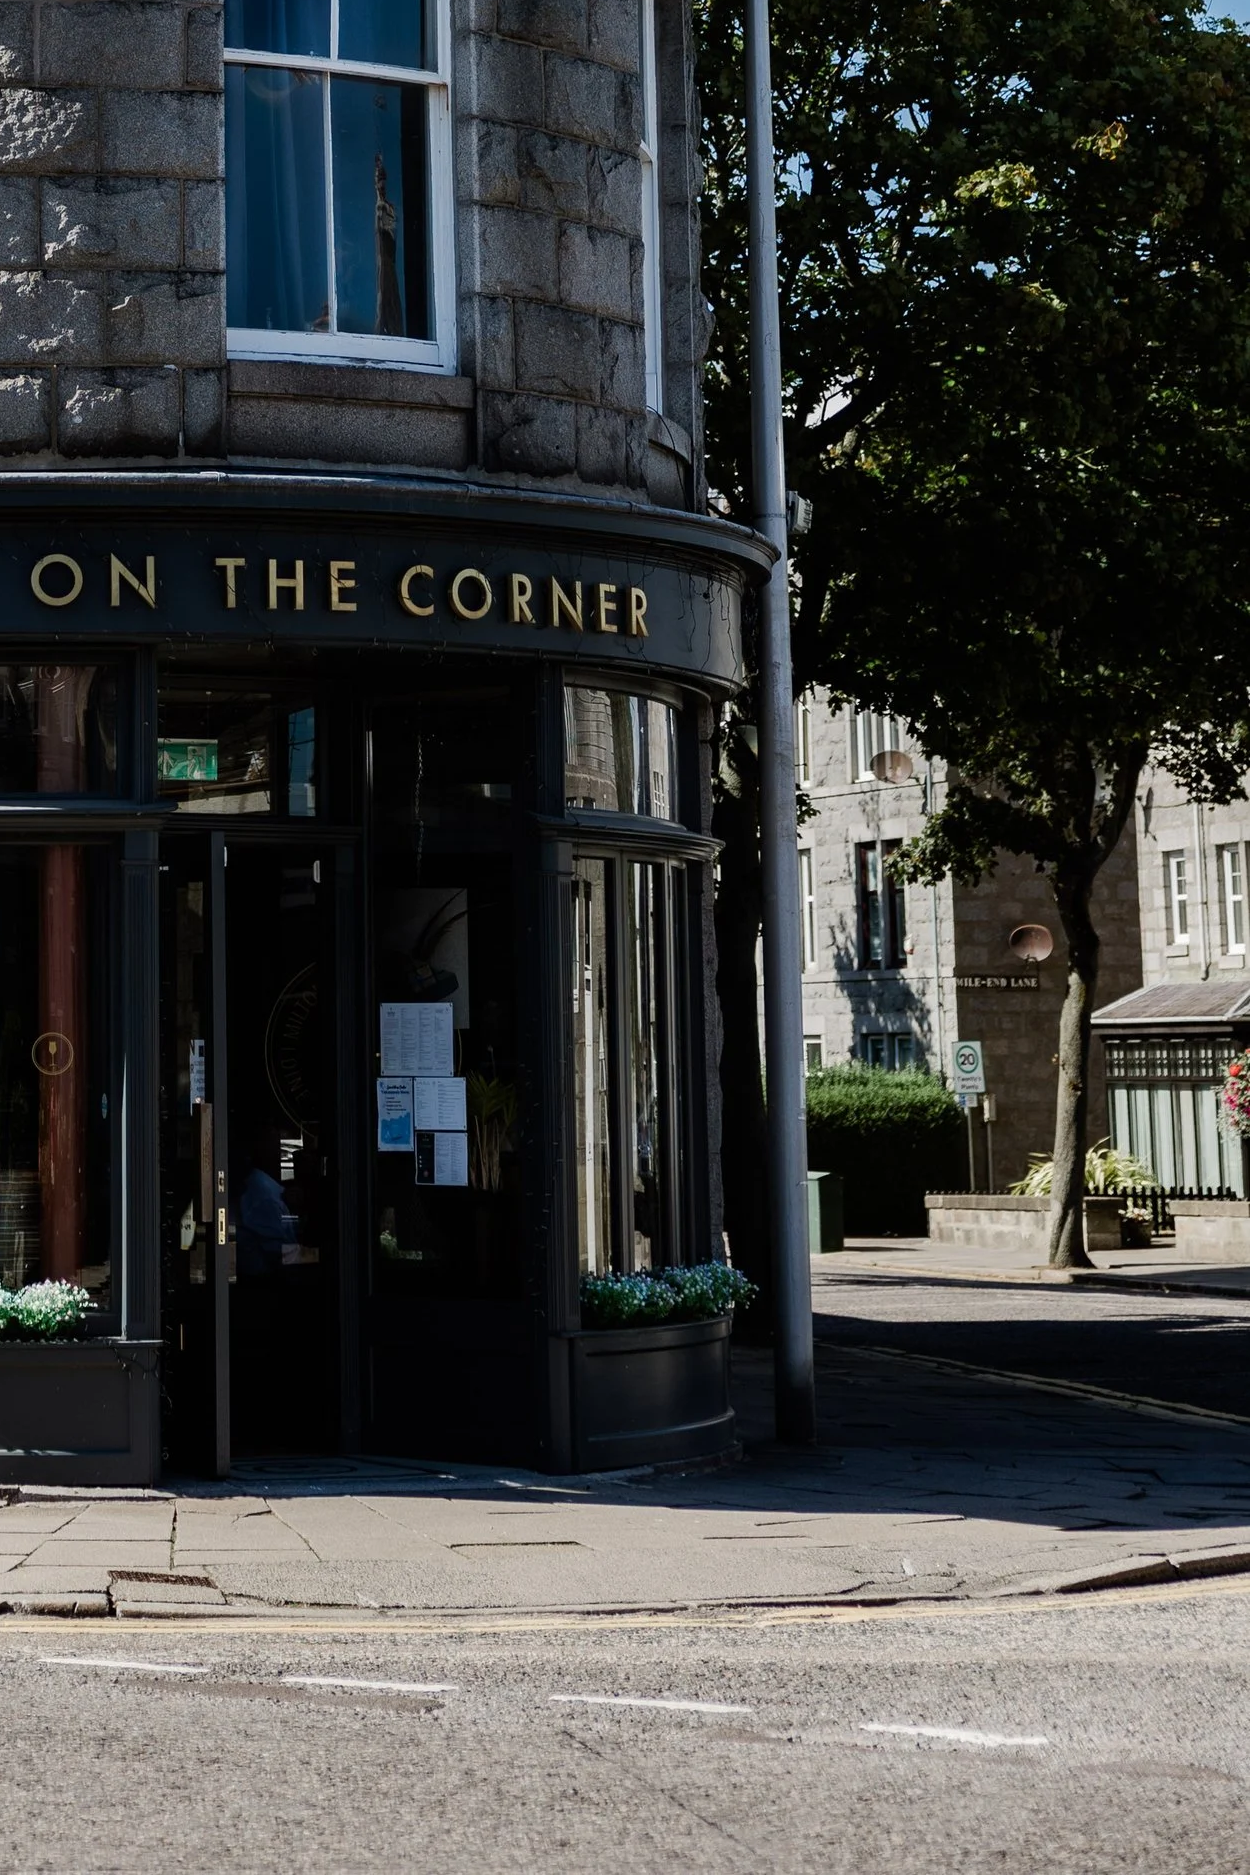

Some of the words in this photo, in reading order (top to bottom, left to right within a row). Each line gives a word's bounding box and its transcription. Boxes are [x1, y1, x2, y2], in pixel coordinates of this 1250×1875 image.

[30, 552, 157, 609] ON
[215, 557, 358, 612] THE
[399, 564, 649, 638] CORNER
[956, 977, 1008, 988] MILE-END
[1010, 977, 1037, 988] LANE
[959, 1053, 976, 1066] 20
